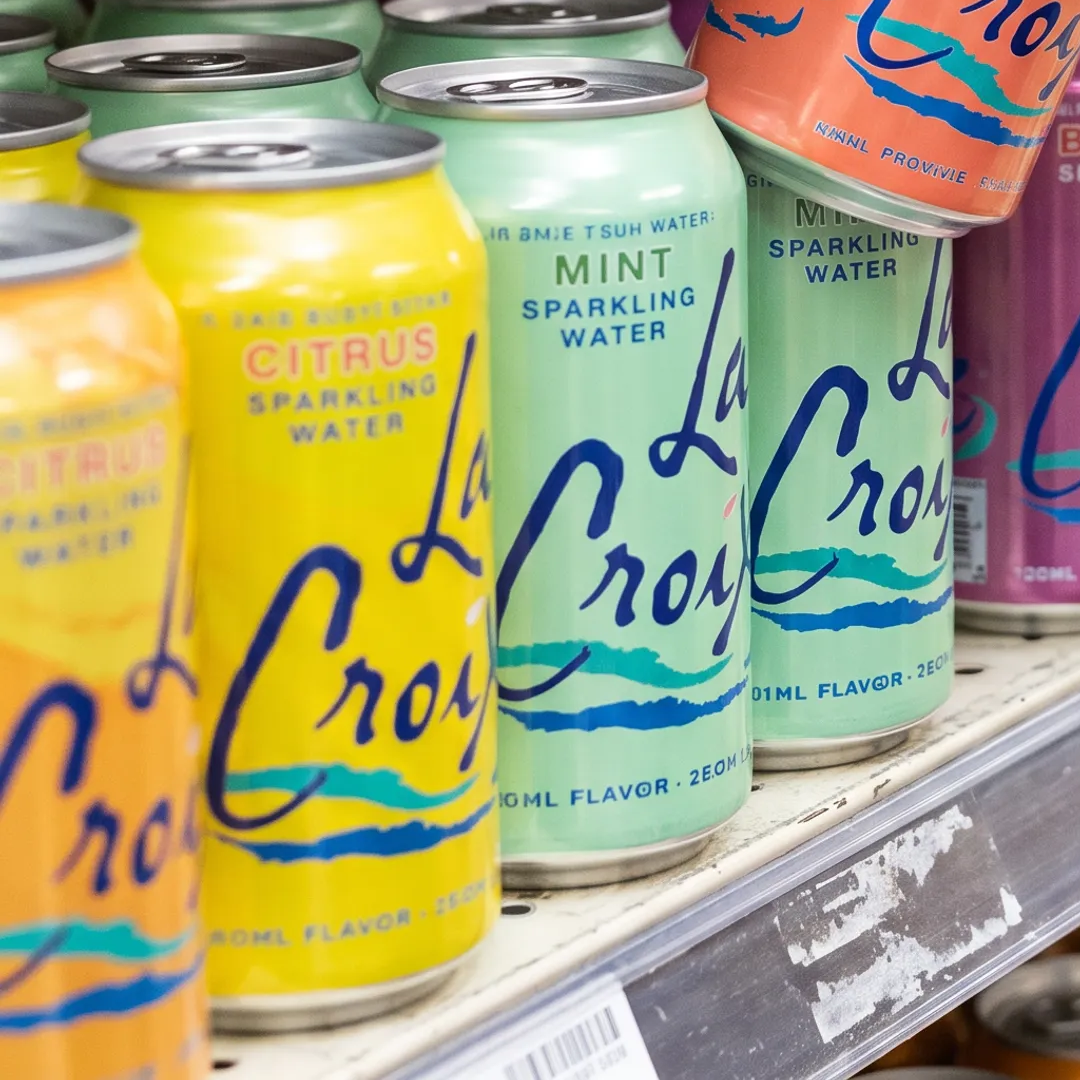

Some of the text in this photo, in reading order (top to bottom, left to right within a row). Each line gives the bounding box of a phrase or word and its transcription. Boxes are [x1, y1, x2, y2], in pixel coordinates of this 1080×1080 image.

[768, 232, 920, 259] SPARKLING
[555, 246, 673, 287] MINT
[804, 258, 898, 284] WATER
[522, 286, 696, 320] SPARKLING
[560, 320, 666, 348] WATER
[243, 322, 438, 381] CITRUS
[648, 247, 748, 479] La
[247, 374, 437, 416] SPARKLING
[289, 412, 405, 446] WATER
[390, 331, 493, 584] La
[817, 671, 903, 699] FLAVOR
[570, 777, 669, 806] FLAVOR
[303, 907, 411, 944] FLAVOR
